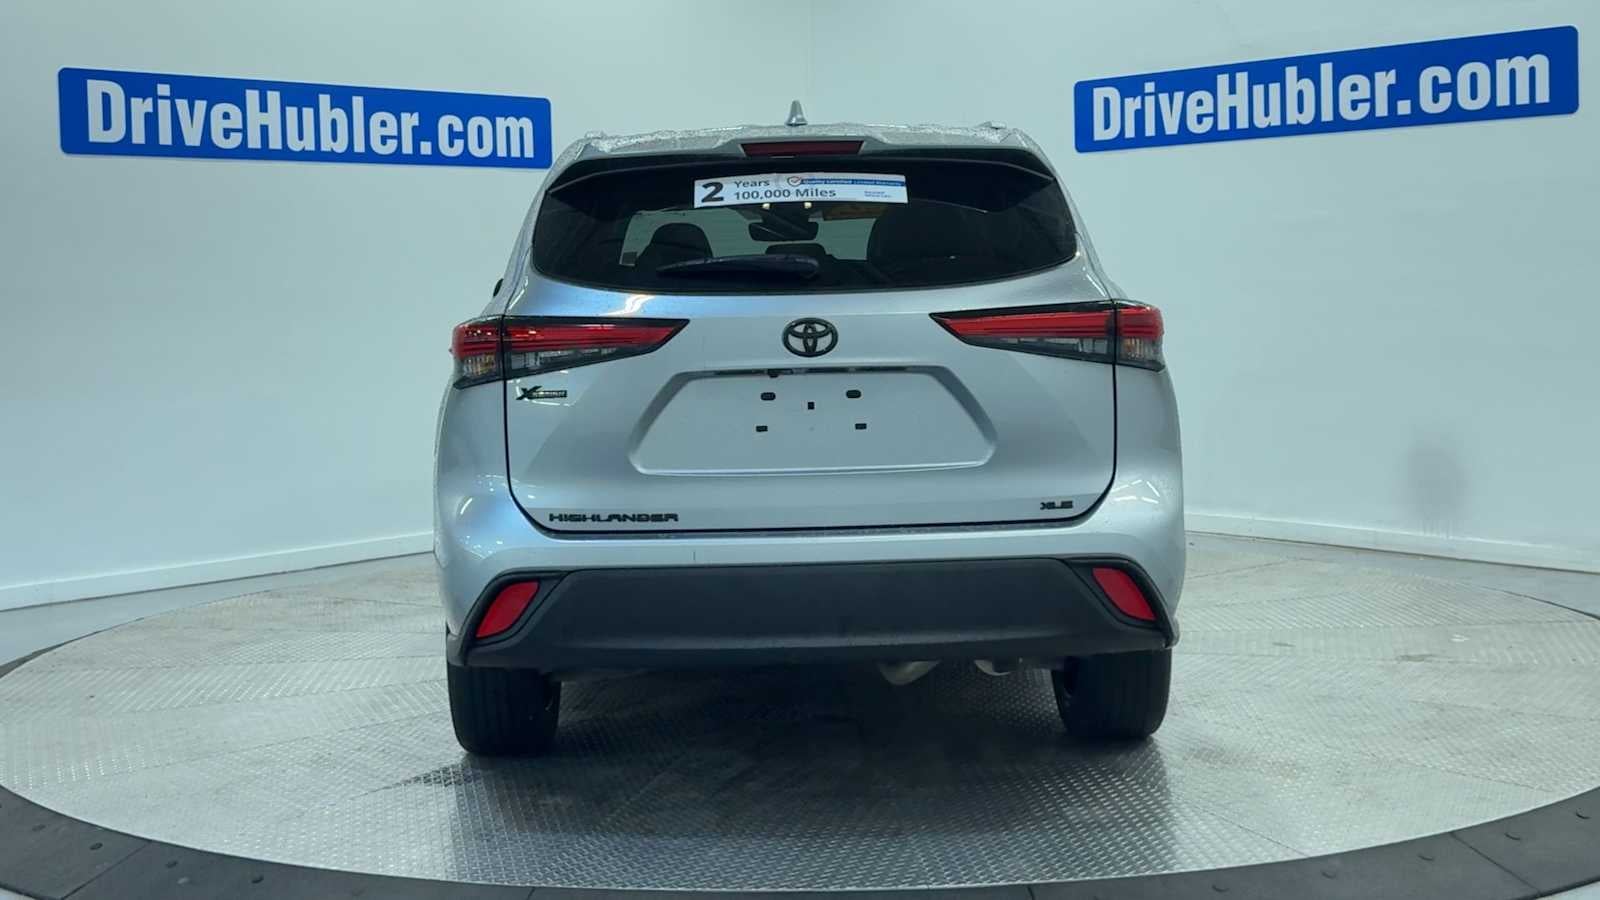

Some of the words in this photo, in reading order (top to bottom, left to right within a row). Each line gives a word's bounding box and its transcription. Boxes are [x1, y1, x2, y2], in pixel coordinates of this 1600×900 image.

[1092, 53, 1551, 141] DriveHubler.com
[86, 79, 535, 159] DriveHubler.com
[734, 180, 770, 188] Years
[701, 182, 725, 203] 2
[734, 189, 791, 200] 100,000
[795, 188, 837, 198] Miles
[549, 513, 679, 522] HIGHLANDER
